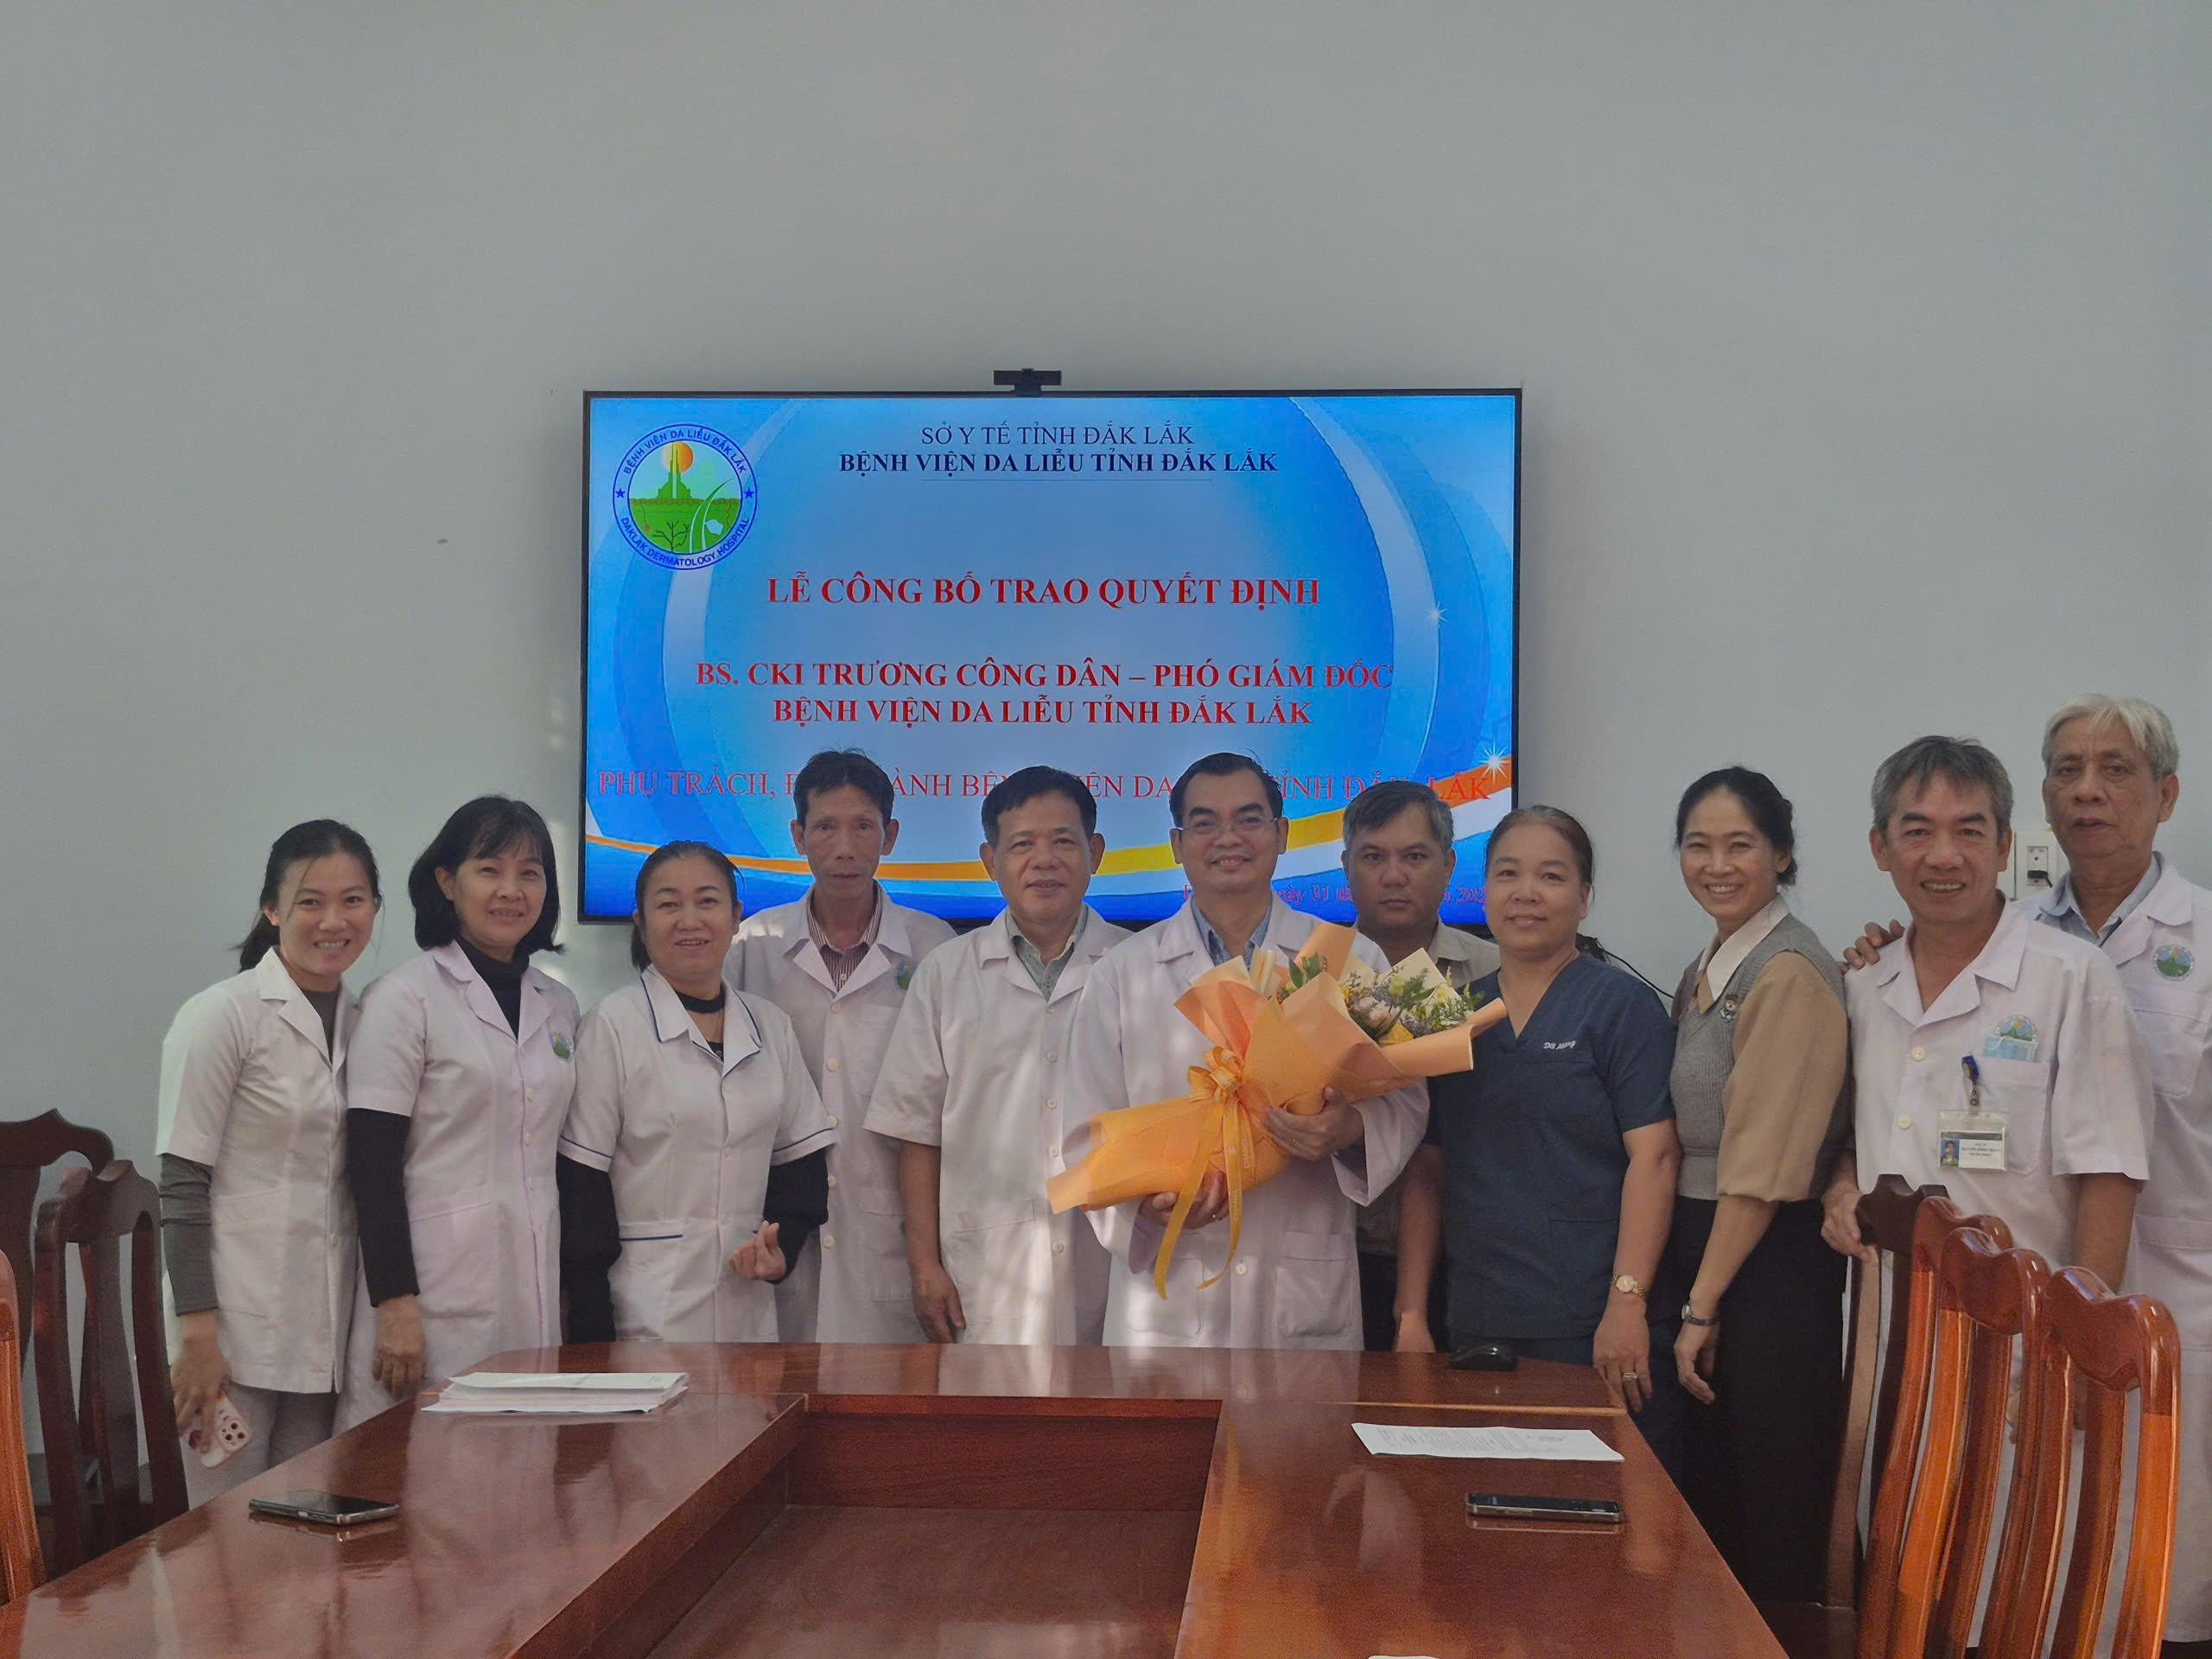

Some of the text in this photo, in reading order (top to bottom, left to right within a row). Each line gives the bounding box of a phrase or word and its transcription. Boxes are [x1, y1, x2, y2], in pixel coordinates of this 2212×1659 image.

[670, 429, 684, 439] DA
[921, 420, 1196, 445] SỞ Y TẾ TỈNH ĐẮK LẮK
[838, 447, 1279, 477] BỆNH VIỆN DA LIỄU TỈNH ĐẮK LẮK
[646, 547, 717, 567] DERMATOLOGY
[717, 518, 751, 556] HOSPITAL
[766, 569, 1321, 612] LỄ CÔNG BỐ TRAO QUYẾT ĐỊNH
[695, 662, 740, 686] BS.
[747, 662, 804, 686] CKI
[811, 659, 948, 687] TRƯƠNG
[956, 656, 1048, 687] CÔNG
[1055, 657, 1121, 688] DÂN
[1153, 658, 1220, 688] PHÓ
[1228, 658, 1315, 688] GIÁM
[1324, 658, 1394, 690] ĐỐC
[772, 693, 1313, 729] BỆNH VIỆN DA LIỄU TỈNH ĐẮK LẮK
[598, 771, 658, 799] PHỤ
[891, 766, 952, 797] ÀNH
[1133, 775, 1173, 798] DA
[1277, 769, 1334, 799] ỈNH
[1310, 884, 1329, 902] 31
[1458, 887, 1487, 904] 202
